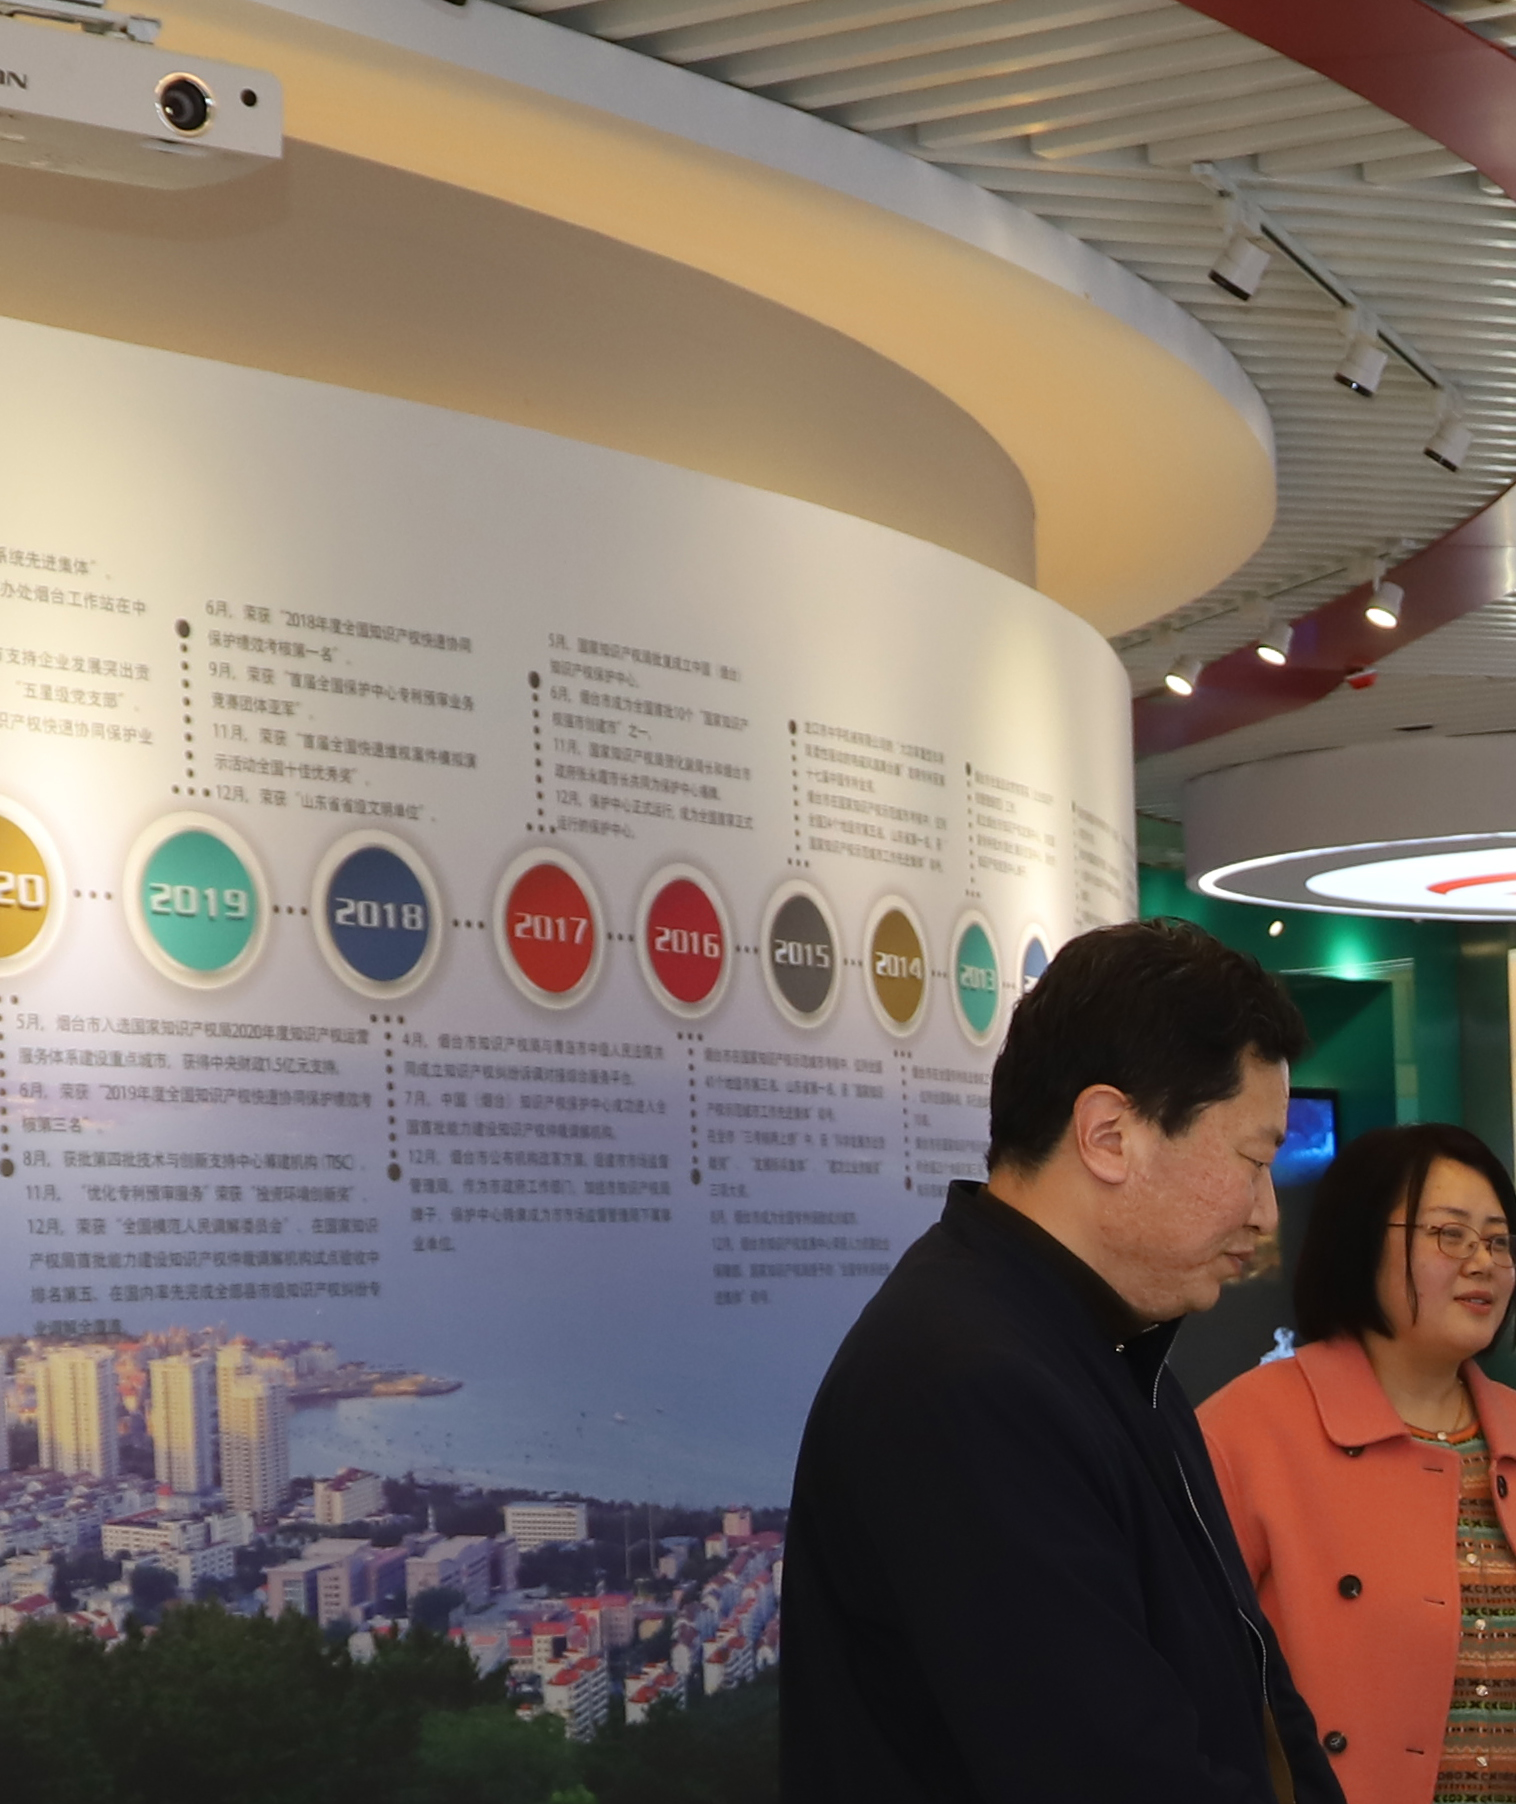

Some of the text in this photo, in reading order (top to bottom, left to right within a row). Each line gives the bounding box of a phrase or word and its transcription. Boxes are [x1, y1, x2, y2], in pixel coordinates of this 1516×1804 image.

[0, 646, 150, 681] 支持企业发展突出贡
[148, 882, 249, 919] 2019
[334, 897, 425, 931] 2018
[513, 912, 588, 945] 2017
[653, 926, 721, 959] 2016
[773, 938, 830, 969] 2015
[874, 951, 922, 978] 2014
